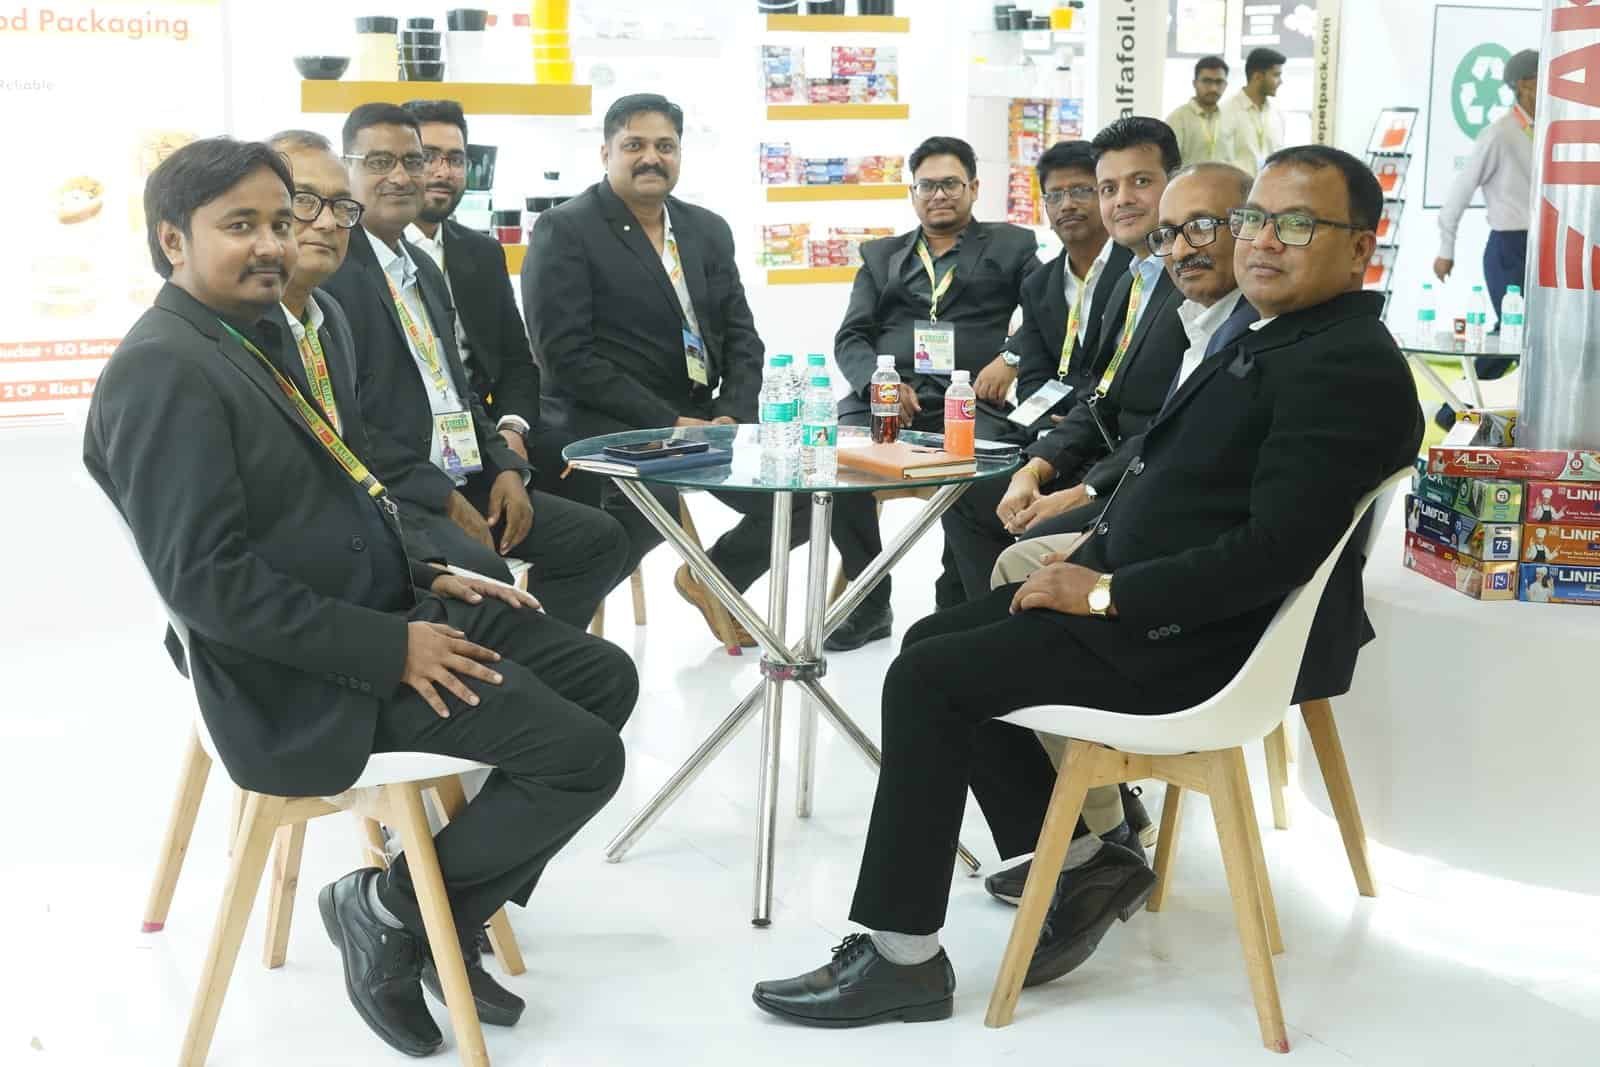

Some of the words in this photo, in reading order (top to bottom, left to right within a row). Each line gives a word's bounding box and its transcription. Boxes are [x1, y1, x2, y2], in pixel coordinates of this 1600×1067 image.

[39, 8, 189, 40] Packaging
[1115, 0, 1135, 119] alfafoil.
[1317, 17, 1331, 145] epetpack.com
[1455, 453, 1498, 466] ALFA
[1566, 489, 1600, 501] UNI
[1495, 540, 1509, 551] 75
